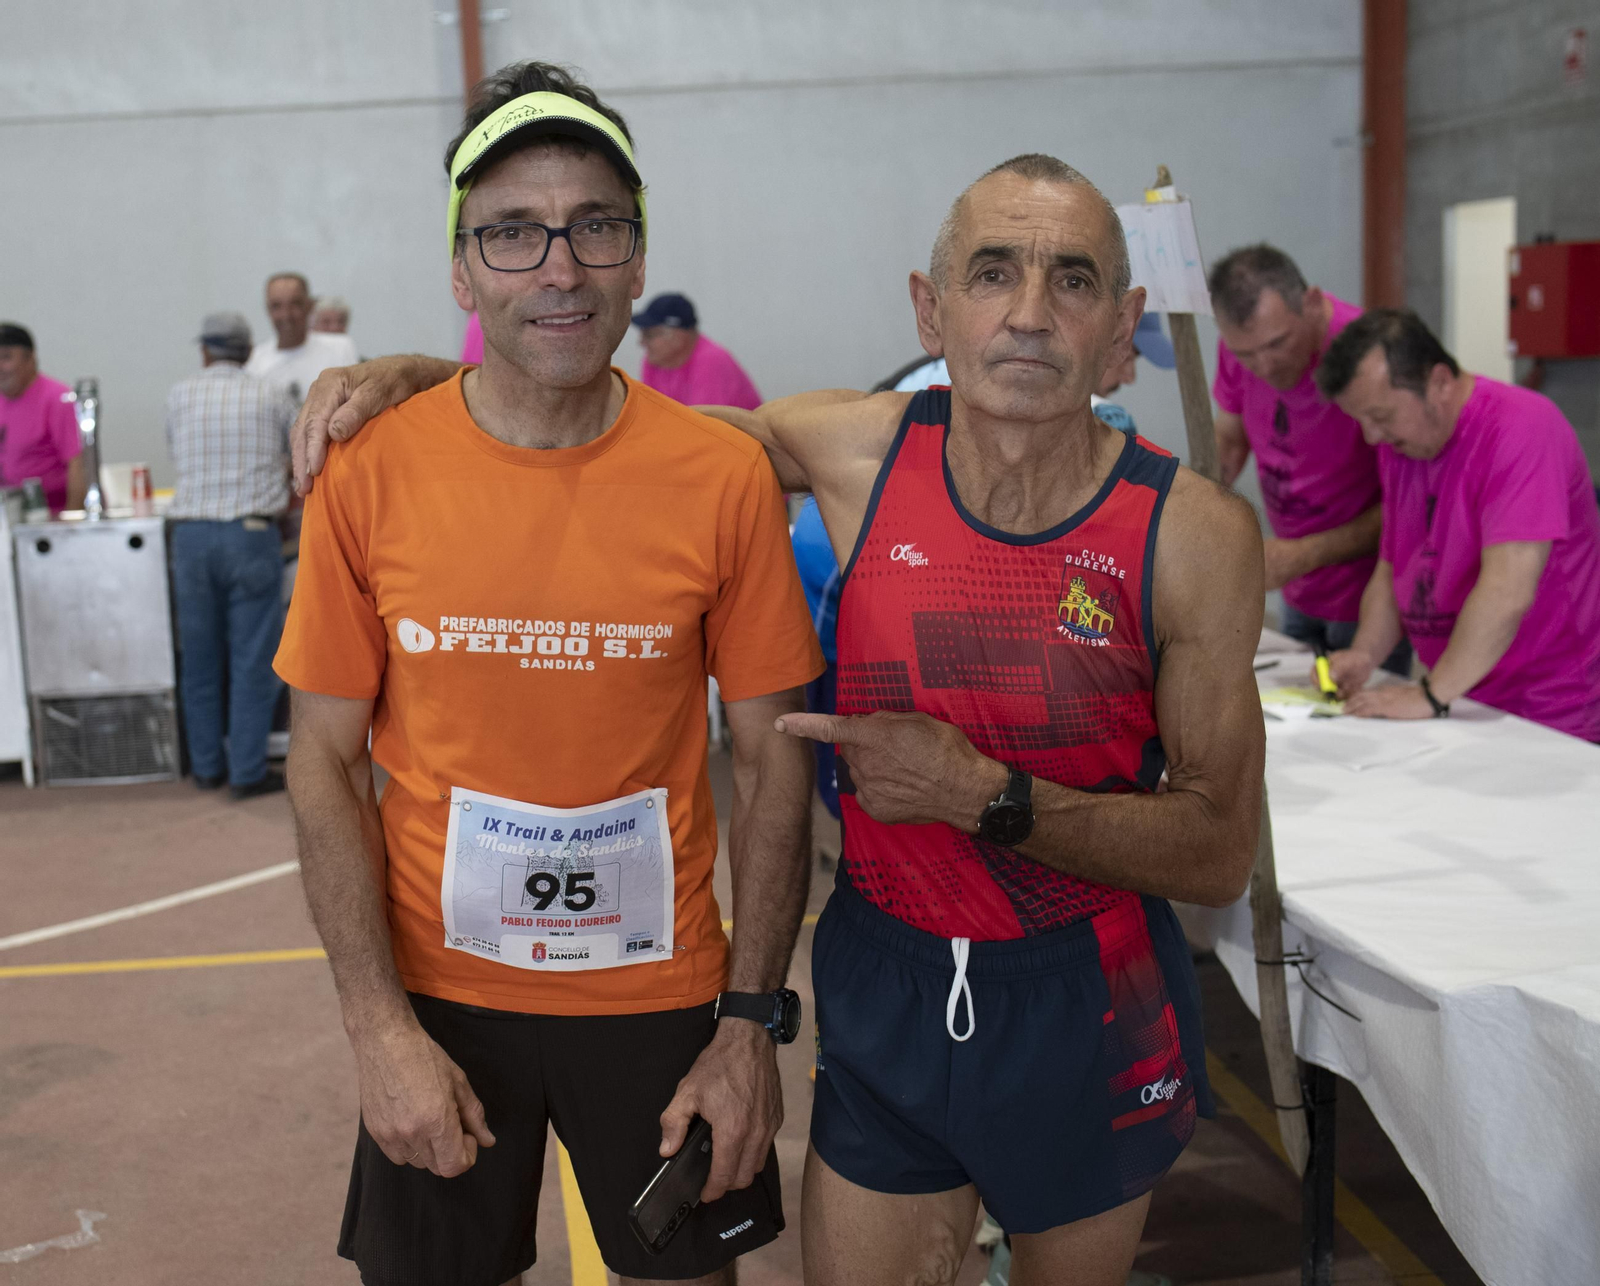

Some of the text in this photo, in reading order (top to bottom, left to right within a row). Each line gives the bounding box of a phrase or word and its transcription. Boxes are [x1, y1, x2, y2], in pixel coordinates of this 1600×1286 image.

[908, 557, 929, 568] sport
[1065, 554, 1126, 579] OURENSE
[1082, 549, 1114, 566] CLUB
[440, 616, 673, 639] PREFABRICADOS DE HORMIGÓN
[1057, 625, 1110, 647] ATLETISMO
[440, 632, 668, 660] FEIJOO S.L.
[519, 658, 595, 671] SANDIÁS
[483, 816, 636, 841] IX Trail & Andaina
[476, 834, 644, 858] Montes de Sandiás
[526, 872, 596, 911] 95
[501, 914, 621, 928] PABLO FEOJOO LOUREIRO
[548, 951, 590, 960] SANDIÁS
[719, 1218, 754, 1240] KIPRUN
